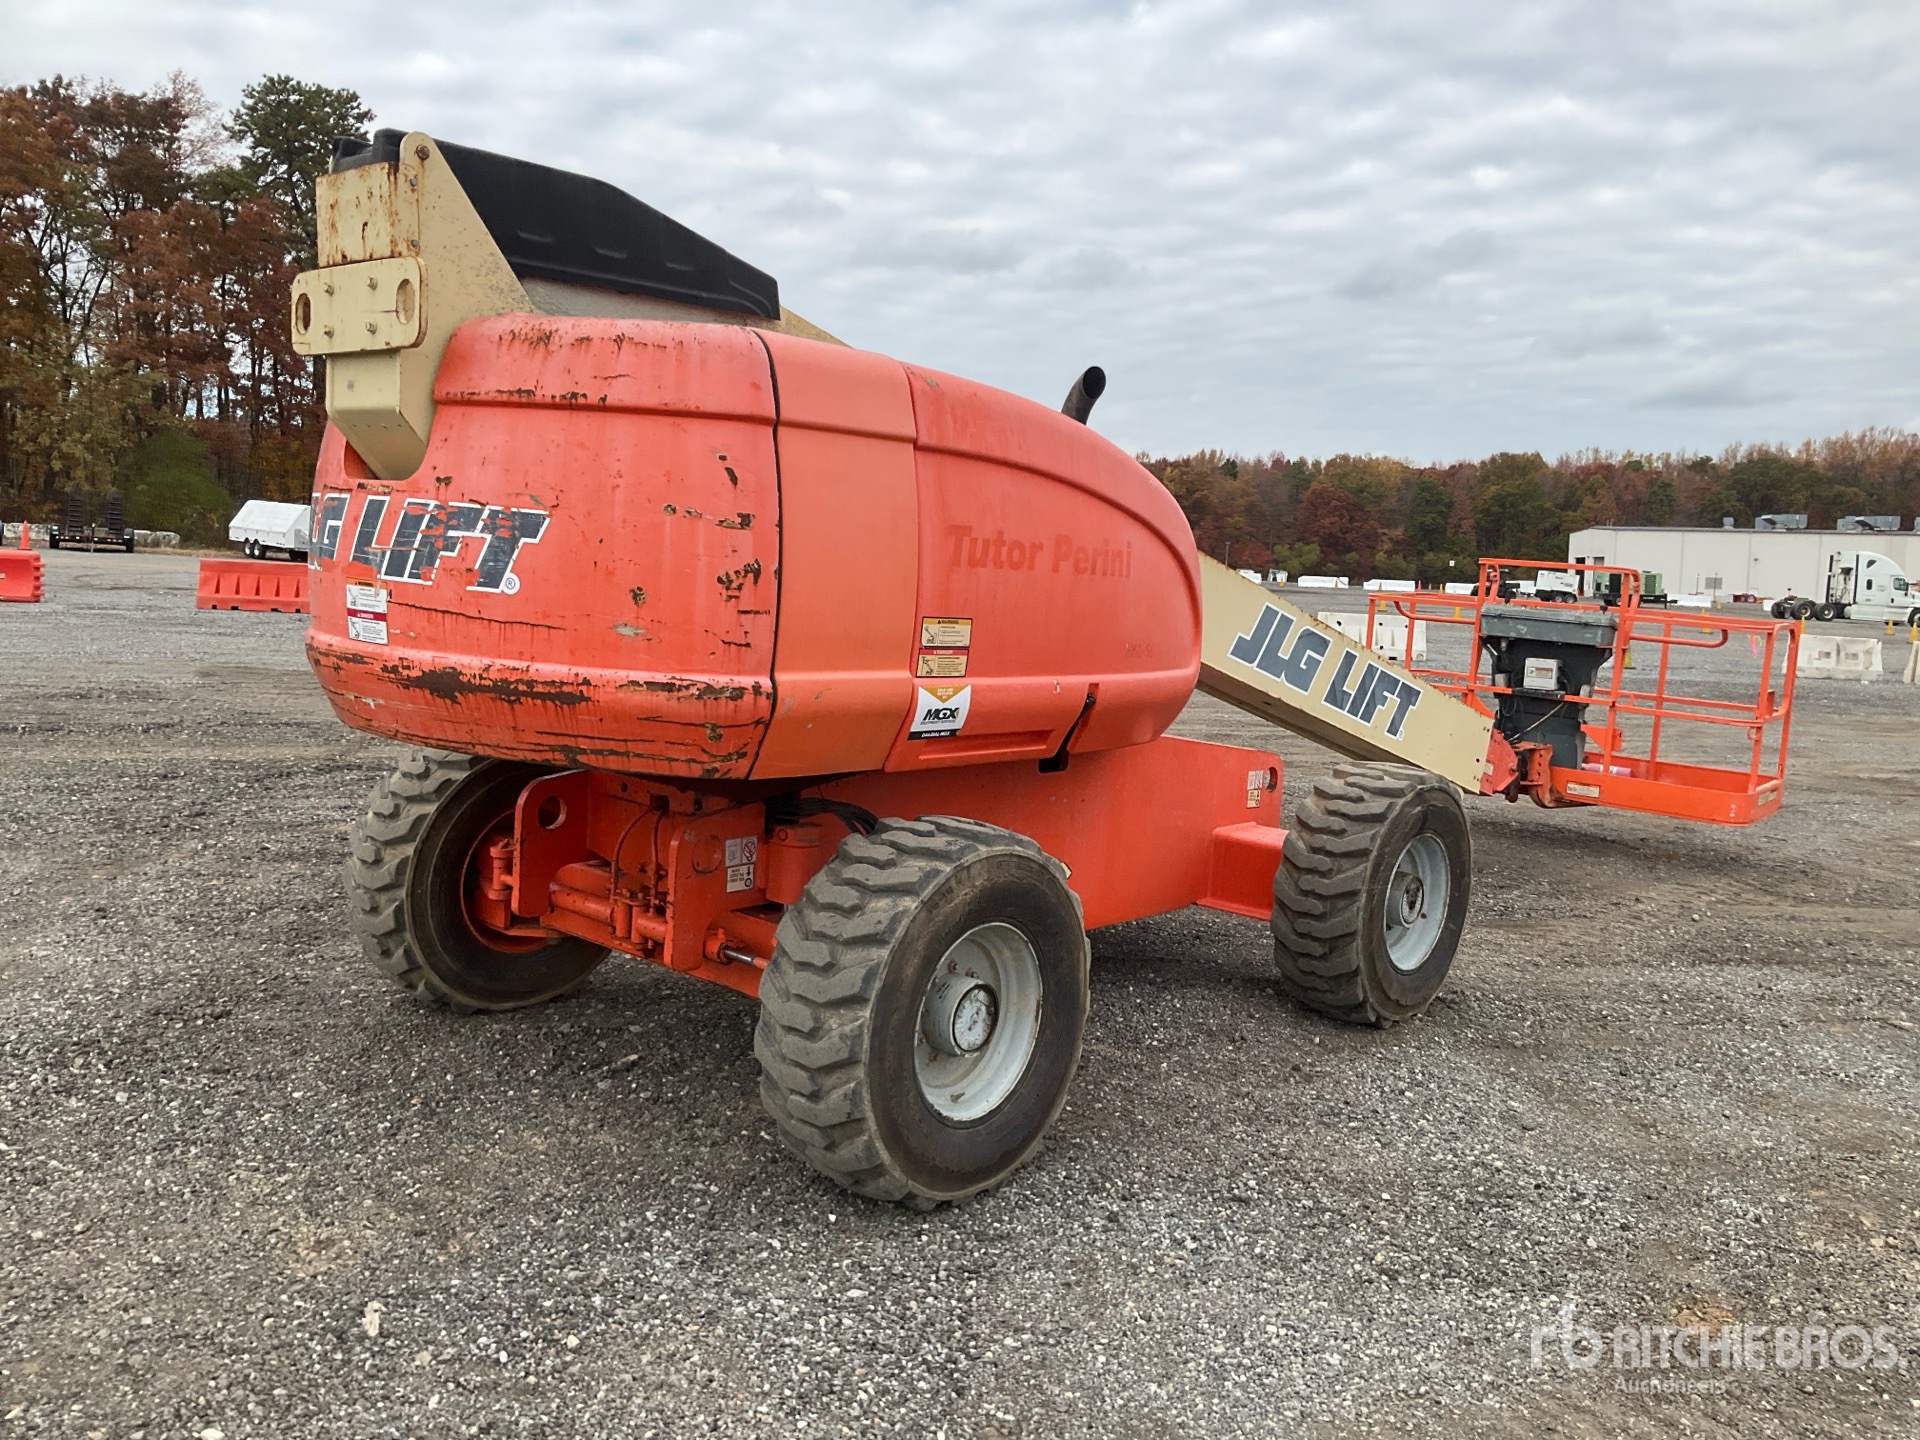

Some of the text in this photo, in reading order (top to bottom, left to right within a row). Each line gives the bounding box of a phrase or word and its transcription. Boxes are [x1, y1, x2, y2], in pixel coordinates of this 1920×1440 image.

[948, 524, 1132, 579] Tutor Perini
[1227, 601, 1333, 696] JLG
[922, 707, 960, 720] MGX
